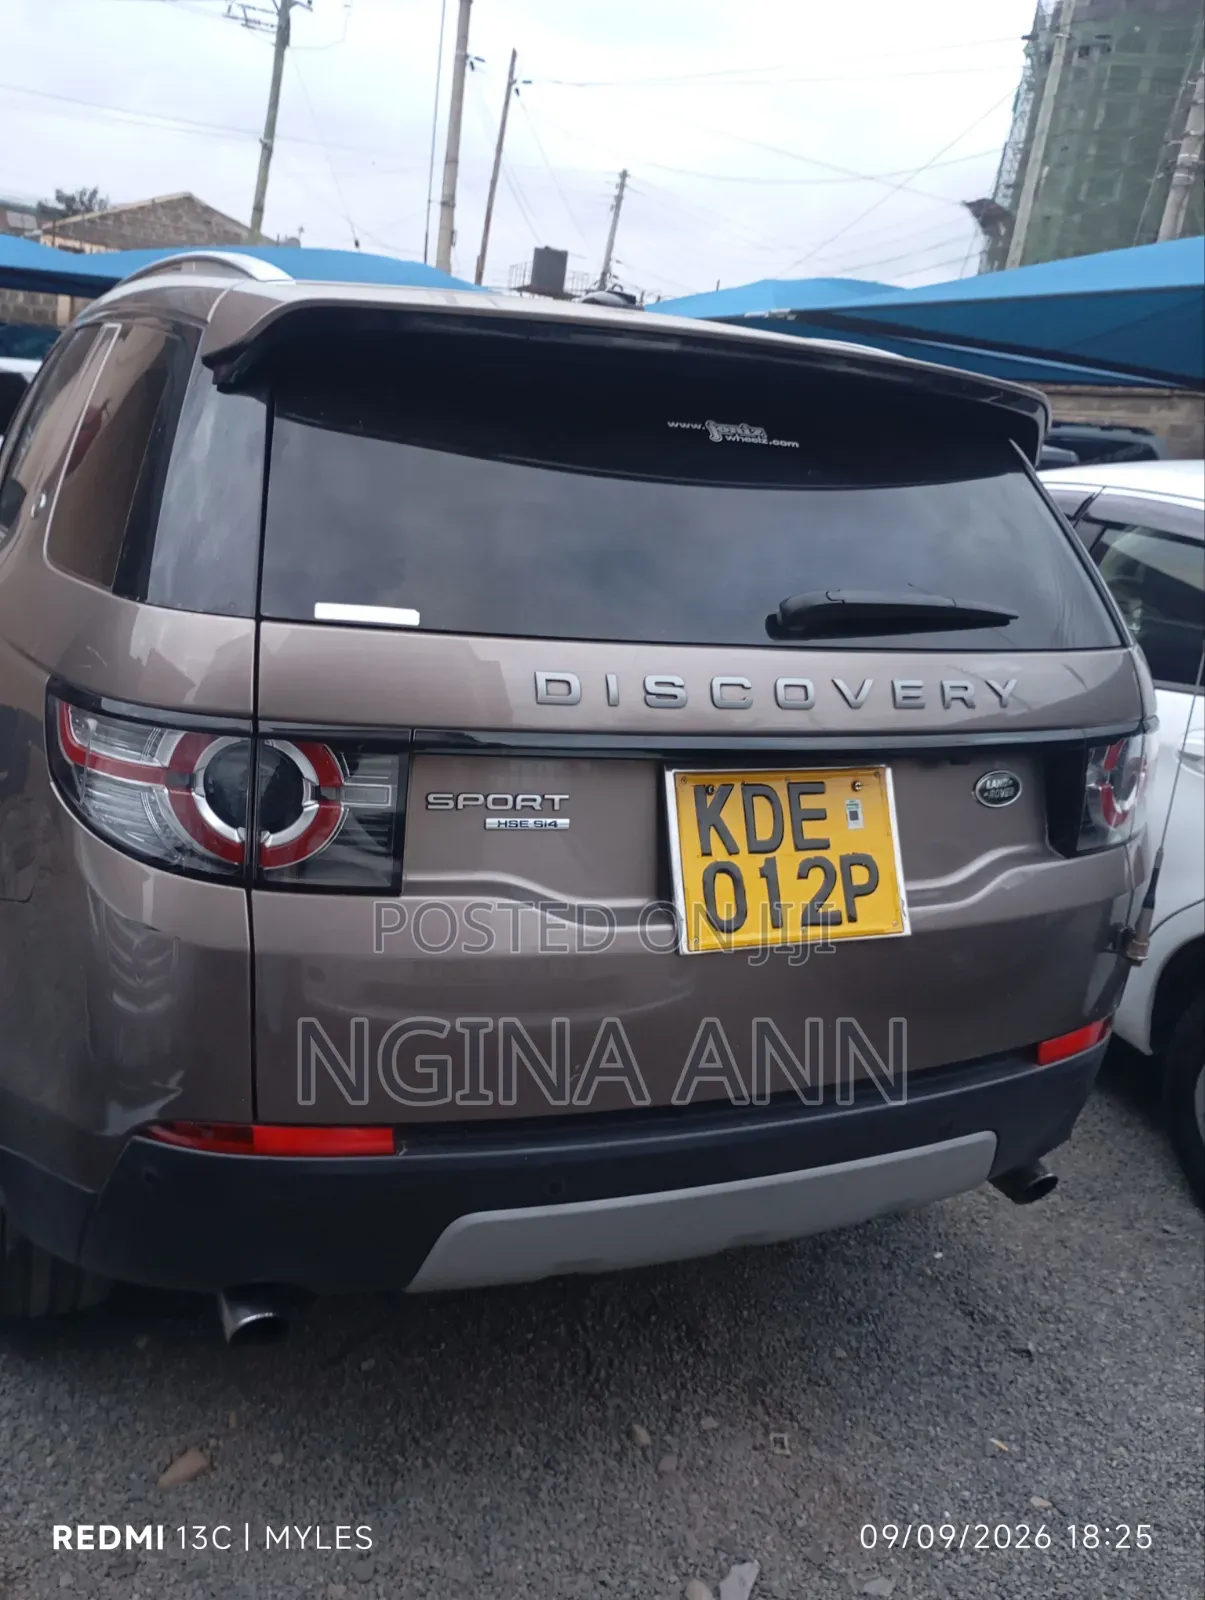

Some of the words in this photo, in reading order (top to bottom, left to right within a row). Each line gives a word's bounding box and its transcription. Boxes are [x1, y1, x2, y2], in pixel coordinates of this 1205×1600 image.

[534, 670, 1018, 710] DISCOVERY
[426, 792, 570, 811] SPORT
[693, 781, 831, 857] KDE
[497, 819, 529, 828] HSE
[533, 819, 558, 828] Si4
[702, 852, 880, 934] 012P
